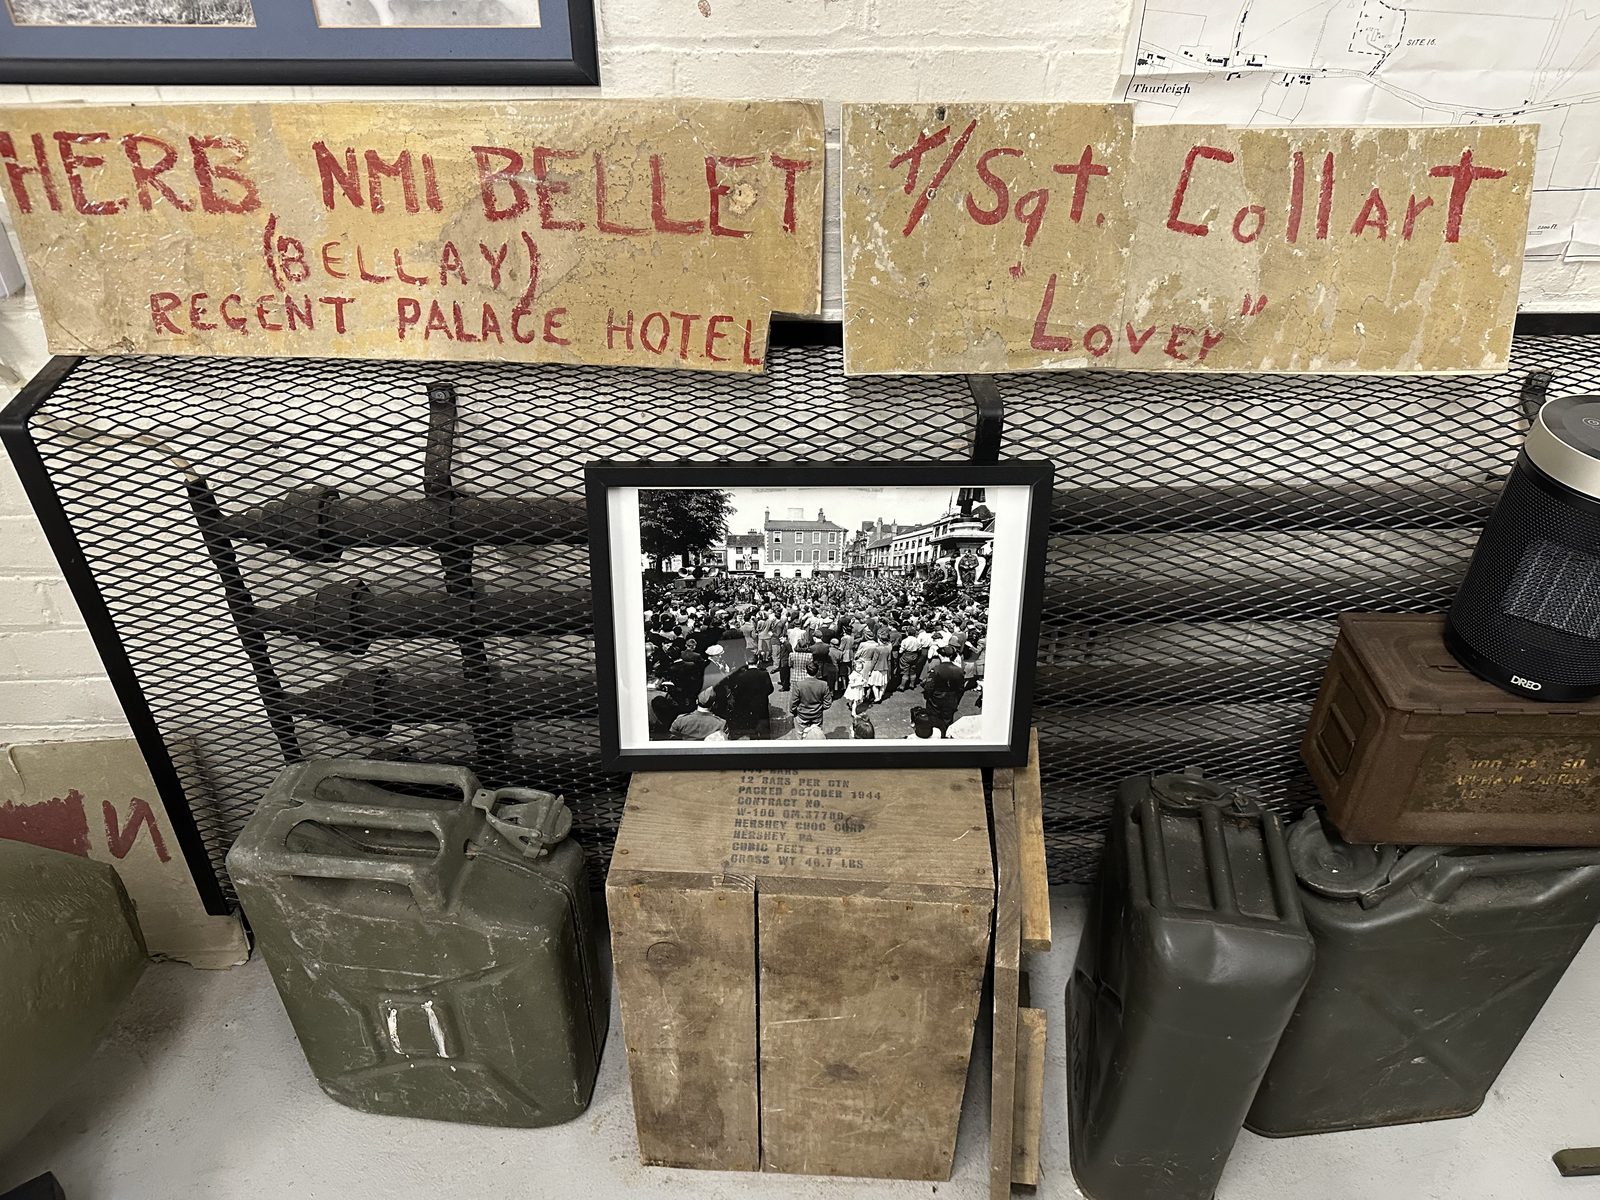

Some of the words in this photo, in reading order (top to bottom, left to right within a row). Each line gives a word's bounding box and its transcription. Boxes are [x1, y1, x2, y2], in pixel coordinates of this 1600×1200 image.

[1132, 83, 1191, 97] Thurleigh
[0, 130, 262, 216] HERB
[312, 140, 443, 216] NMI
[472, 145, 813, 238] BELLET
[263, 214, 542, 310] (BELLAY)
[397, 297, 571, 346] PALACE
[605, 307, 765, 366] HOTEL
[1510, 674, 1542, 691] DREO
[740, 776, 754, 784] 12
[761, 777, 791, 786] BARS
[799, 778, 821, 787] PER
[828, 779, 850, 788] CTN
[738, 786, 782, 796] PACKED
[791, 788, 842, 798] OCTOBER
[850, 791, 881, 800] 1944
[737, 797, 798, 808] CONTRACT
[734, 818, 787, 830] HERSHEY
[795, 822, 826, 831] CHOC
[833, 822, 865, 833] CORP
[731, 842, 768, 852] CUBIC
[776, 844, 804, 853] FEET
[815, 846, 842, 856] 1.02
[730, 854, 770, 865] GROSS
[778, 856, 795, 866] WT
[841, 859, 864, 869] LBS
